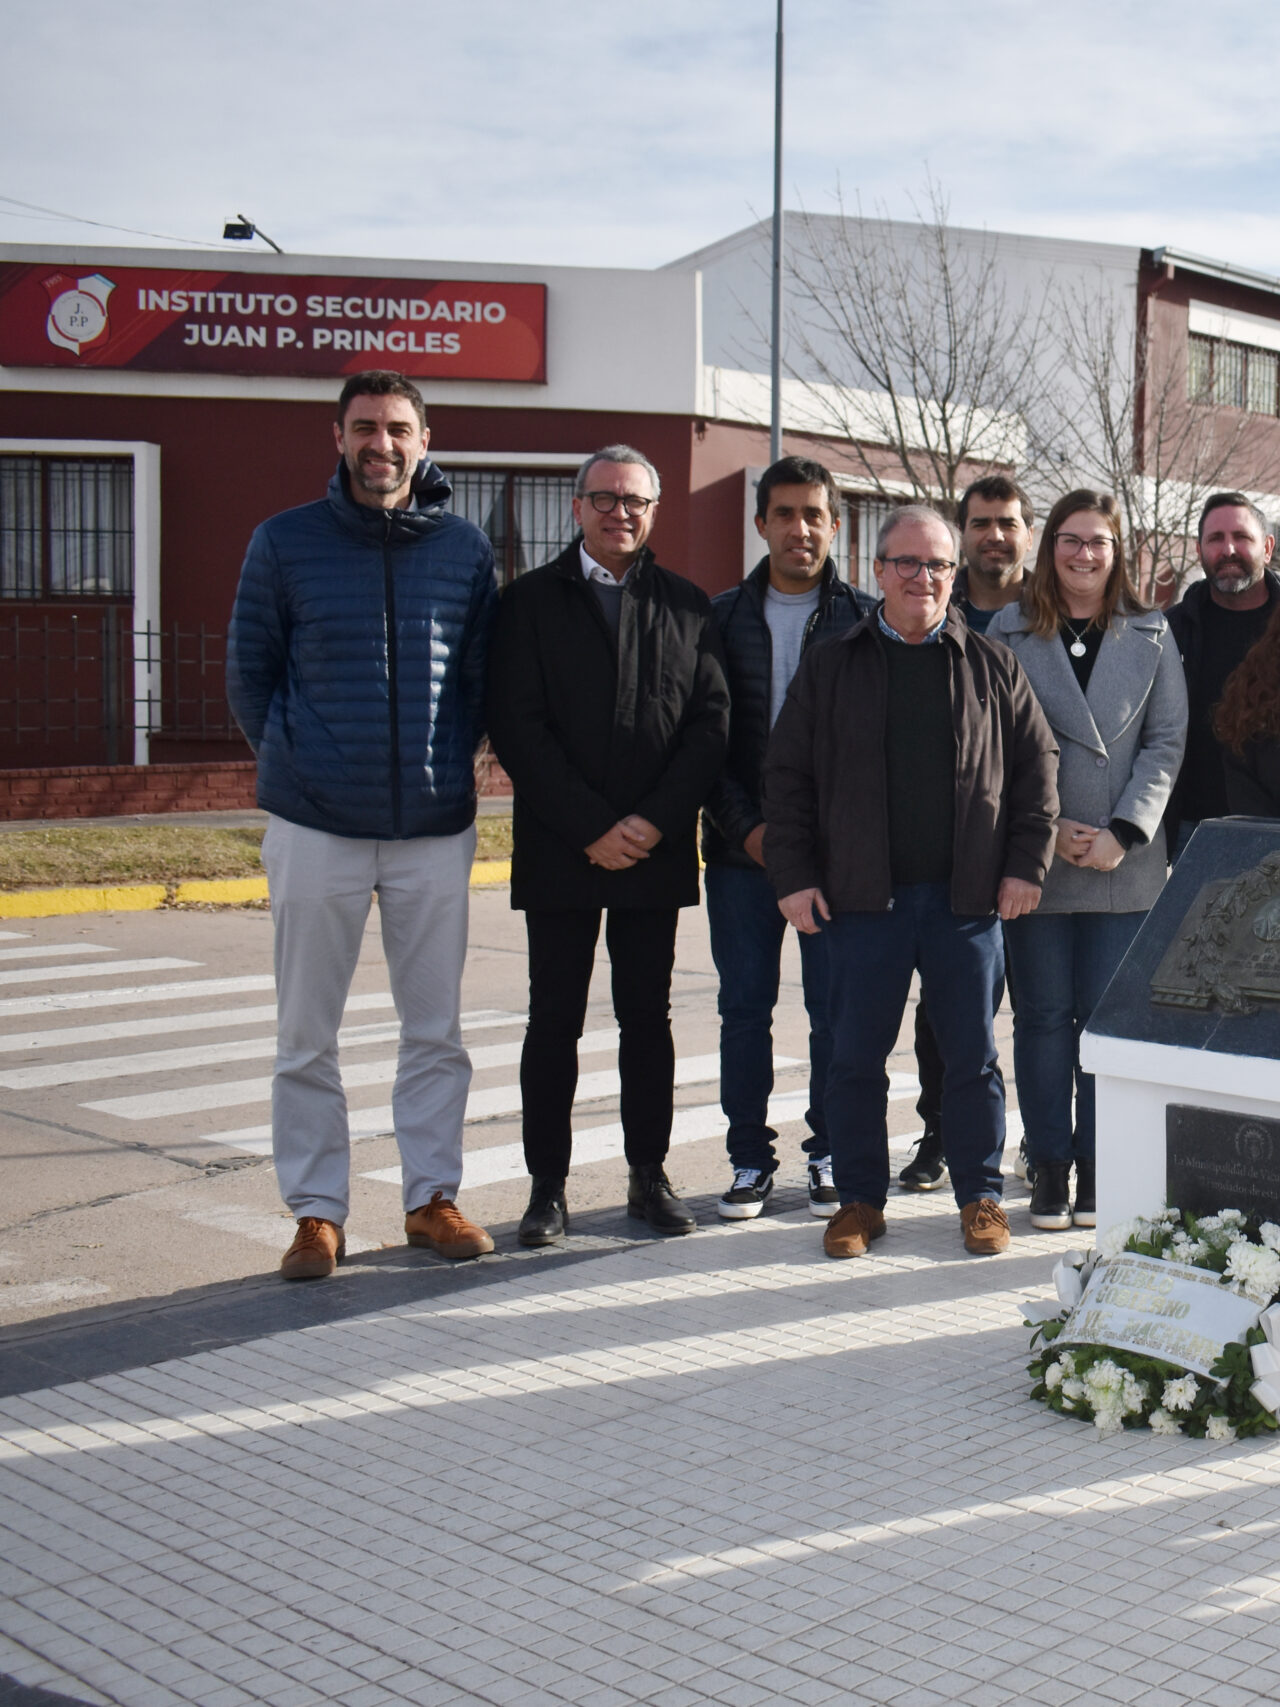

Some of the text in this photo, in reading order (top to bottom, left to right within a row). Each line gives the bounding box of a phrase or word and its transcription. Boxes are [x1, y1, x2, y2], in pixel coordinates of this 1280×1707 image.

[138, 289, 506, 324] INSTITUTO SECUNDARIO
[184, 324, 461, 354] JUAN P. PRINGLES
[1101, 1266, 1174, 1295] PUEBLO
[1096, 1286, 1190, 1319] GOBIERNO
